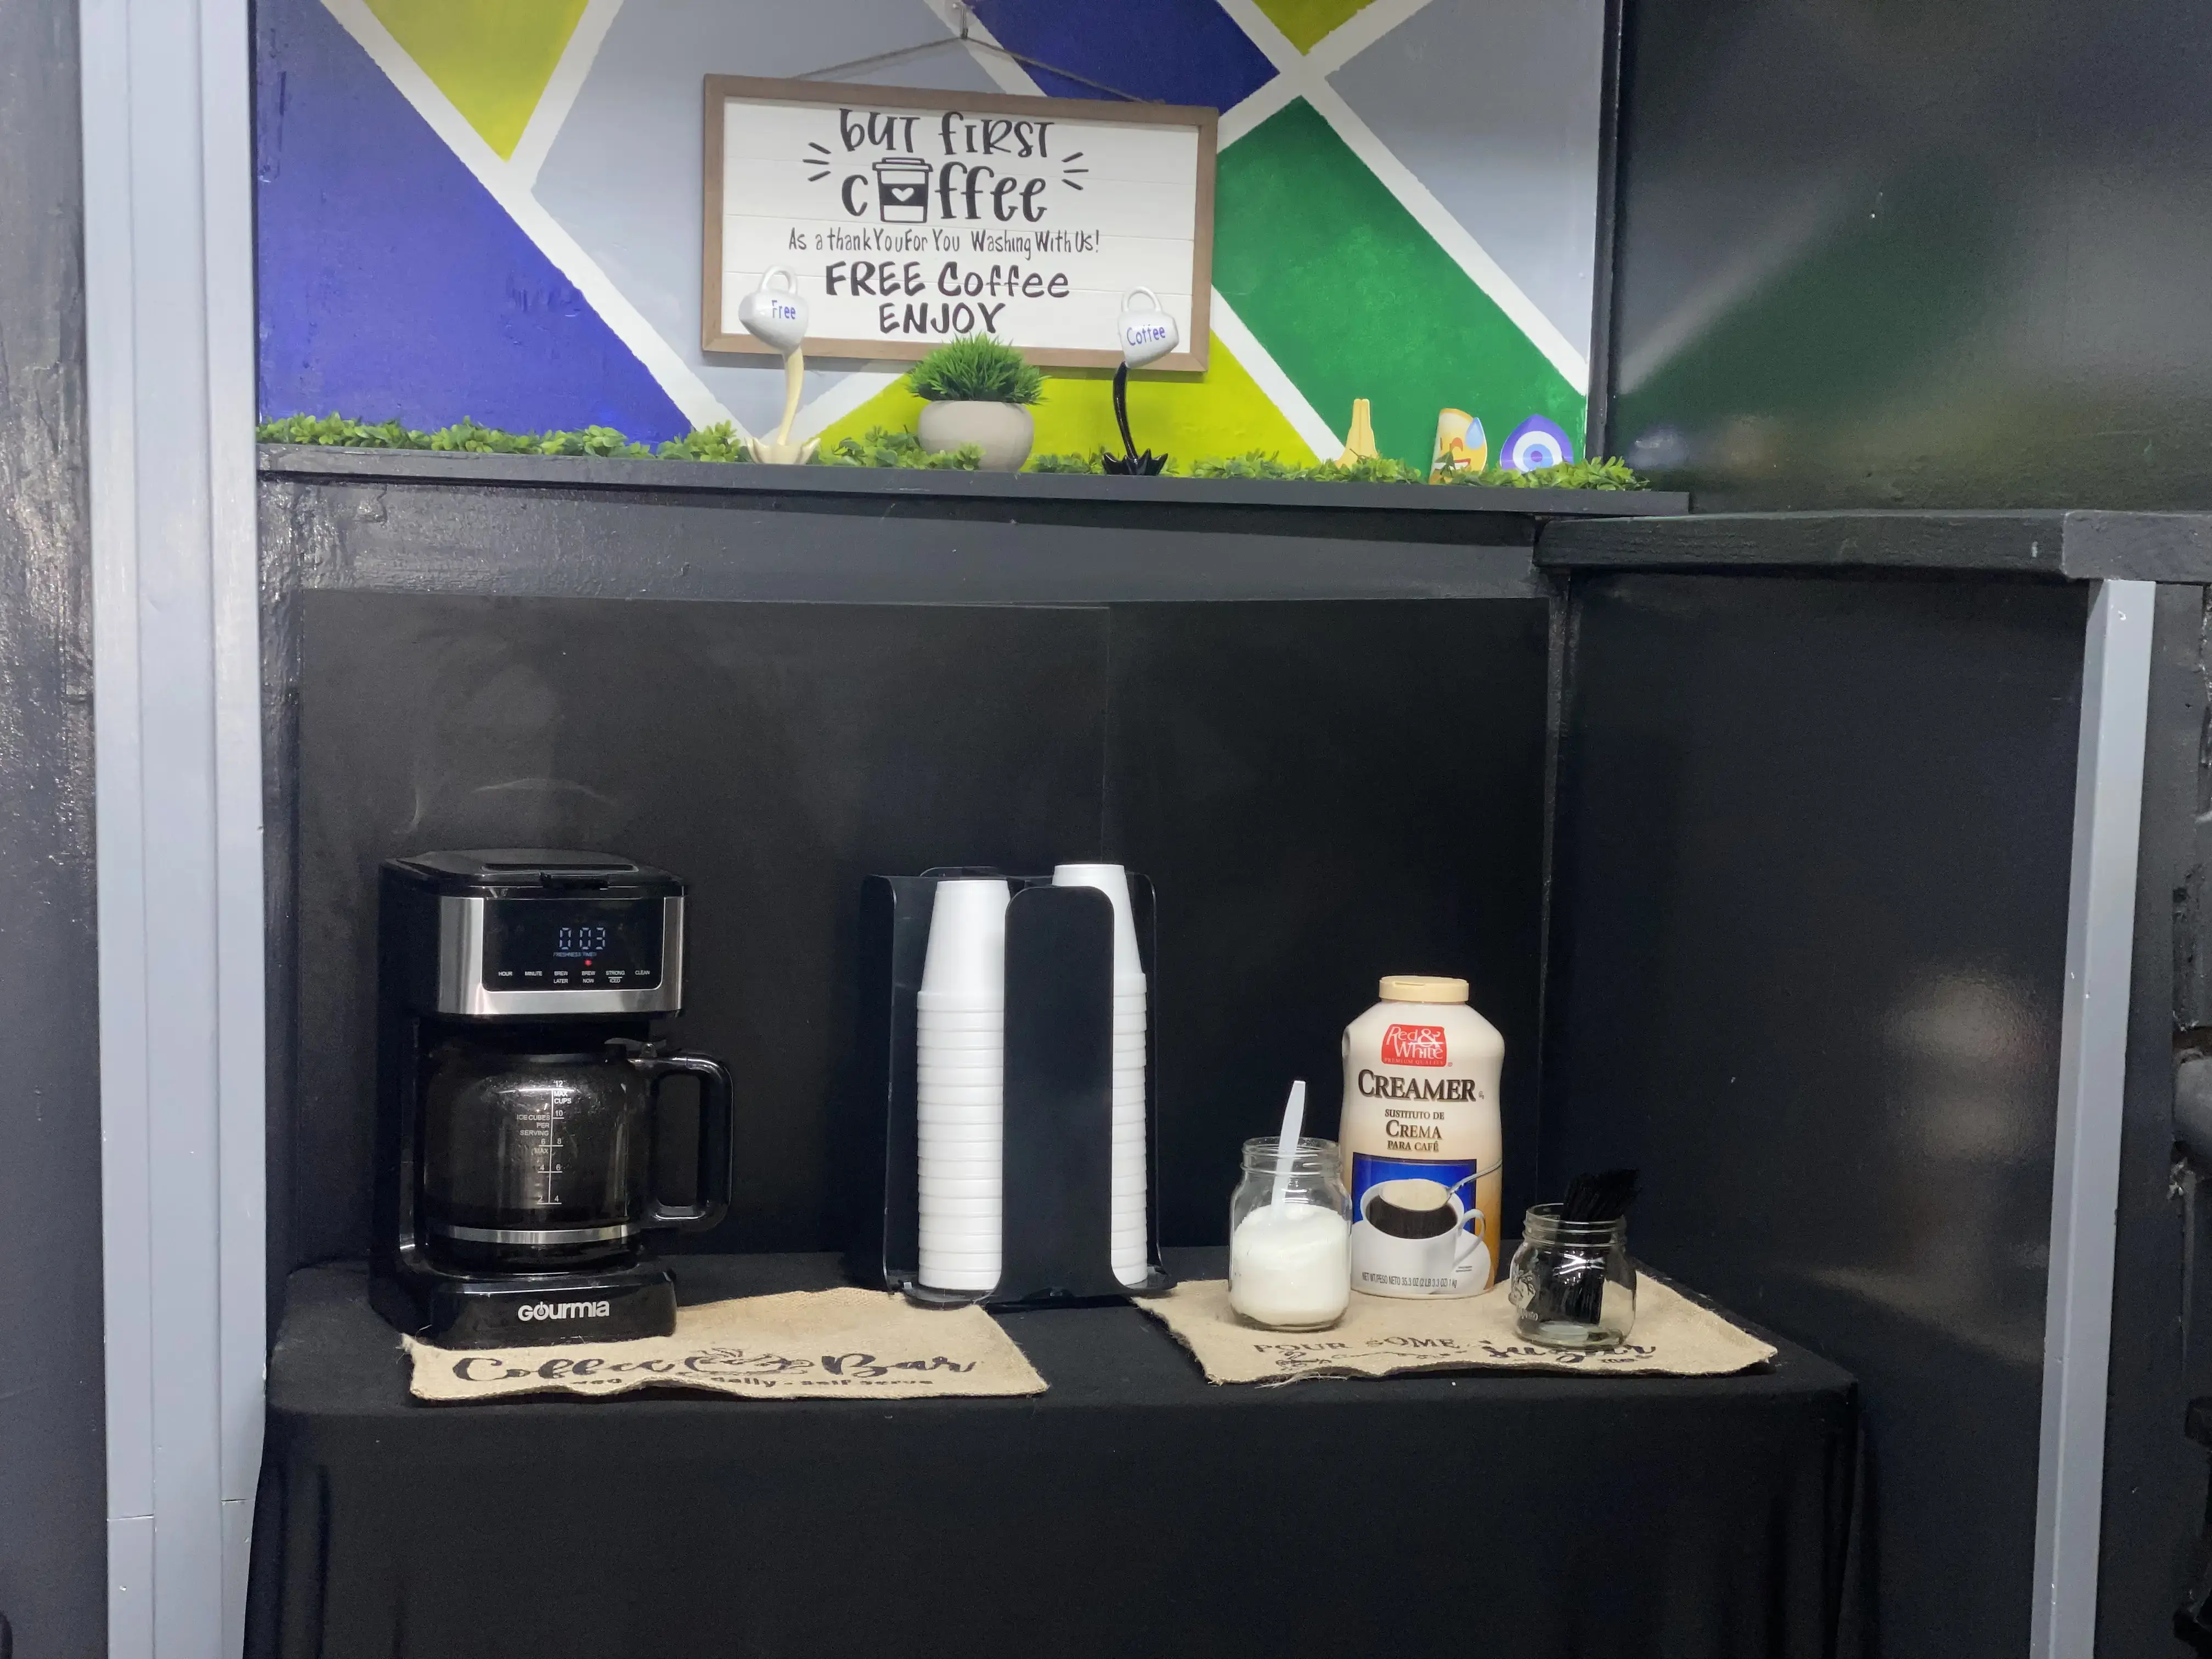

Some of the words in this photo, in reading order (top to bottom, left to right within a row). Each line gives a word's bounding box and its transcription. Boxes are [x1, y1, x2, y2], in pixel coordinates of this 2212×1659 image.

[788, 227, 807, 250] As
[816, 232, 823, 250] a
[827, 227, 871, 250] thank
[873, 228, 904, 252] You
[932, 228, 960, 252] You
[972, 229, 1031, 261] Washing
[1035, 231, 1072, 252] With
[1075, 230, 1099, 254] Us!
[826, 261, 926, 297] FREE
[937, 261, 1070, 298] Coffee
[771, 300, 796, 320] Free
[879, 302, 1006, 334] ENJOY
[1126, 324, 1166, 346] Coffee
[1386, 1026, 1418, 1045] Red
[1393, 1041, 1444, 1059] White
[555, 1080, 563, 1088] 12
[1358, 1069, 1476, 1102] CREAMER
[1385, 1109, 1430, 1120] SUSTITUTO
[1432, 1111, 1444, 1120] DE
[1386, 1119, 1442, 1140] CREMA
[1387, 1141, 1412, 1150] PARA
[1414, 1141, 1439, 1153] CAFÉ
[1389, 1276, 1401, 1285] NETO
[1401, 1277, 1412, 1286] 35.3
[518, 1301, 610, 1321] Gourmia
[1253, 1342, 1352, 1352] POUR
[821, 1353, 976, 1377] Bar
